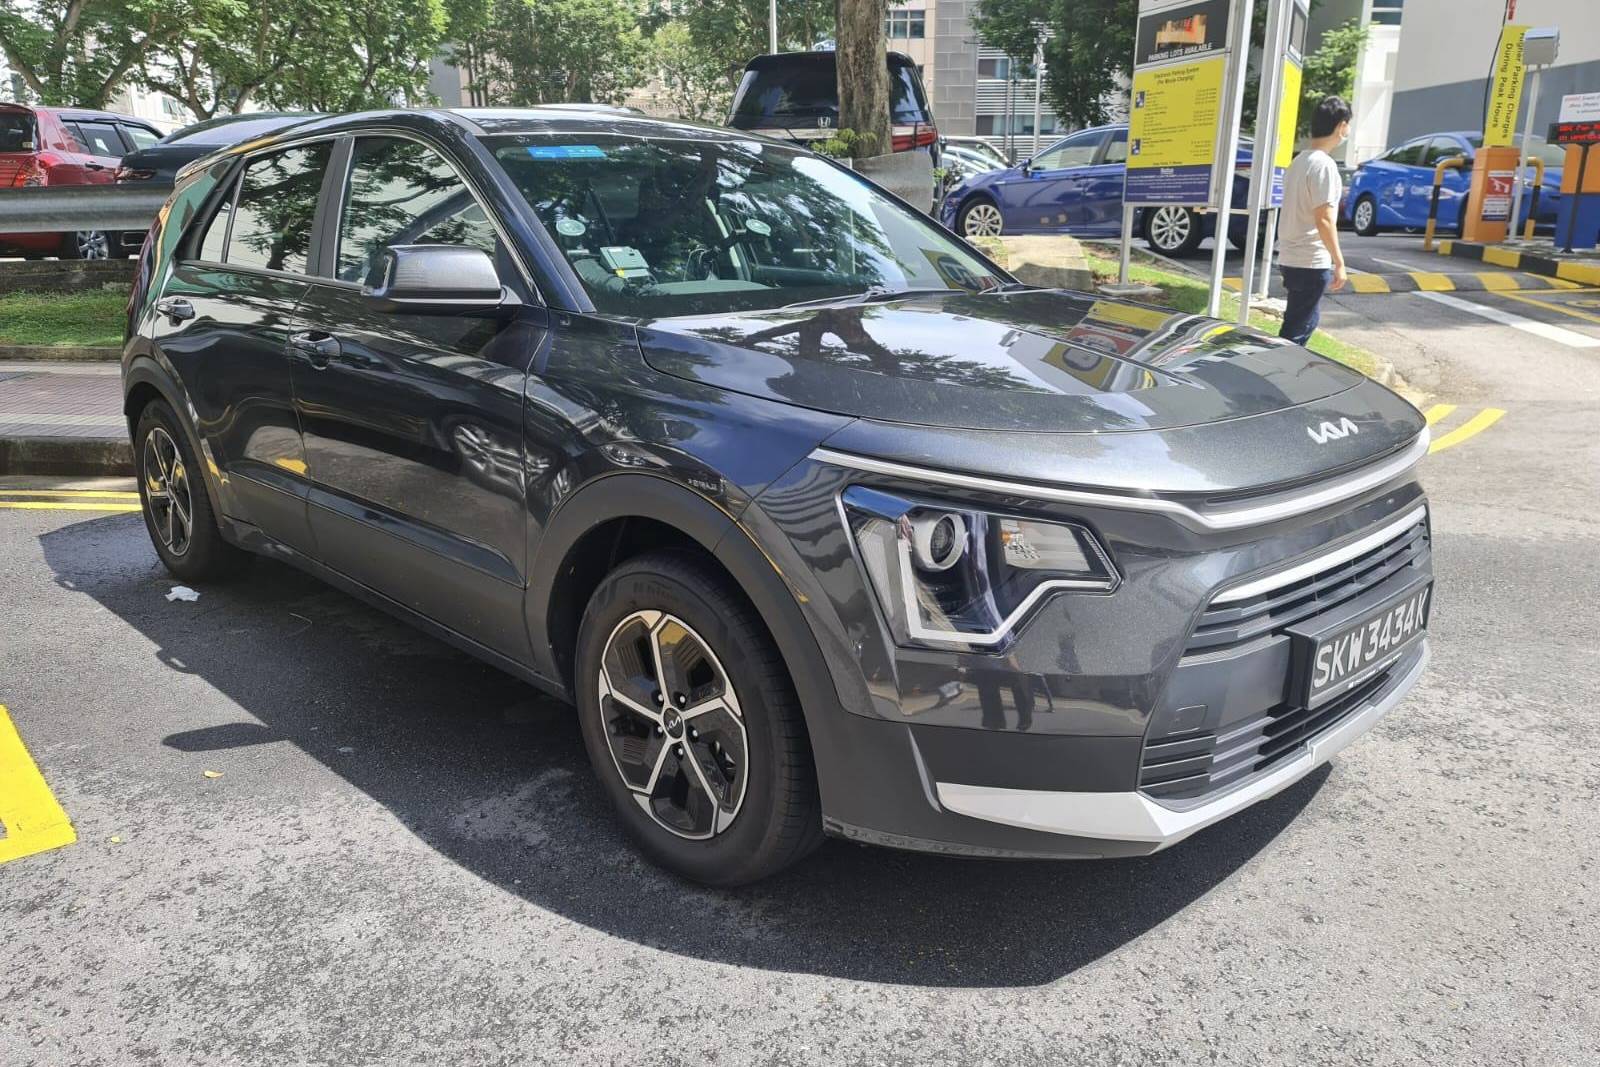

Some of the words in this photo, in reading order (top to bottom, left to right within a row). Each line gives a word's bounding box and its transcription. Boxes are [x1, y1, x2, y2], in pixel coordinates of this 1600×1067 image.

[1148, 51, 1169, 62] PARKING
[1169, 48, 1184, 58] LOTS
[1184, 42, 1213, 55] AVAILABLE
[1500, 43, 1513, 73] During
[1497, 77, 1508, 98] Peak
[1507, 65, 1521, 99] Parking
[1492, 102, 1503, 128] Hours
[1502, 103, 1515, 139] Charges
[1307, 417, 1359, 444] KIA
